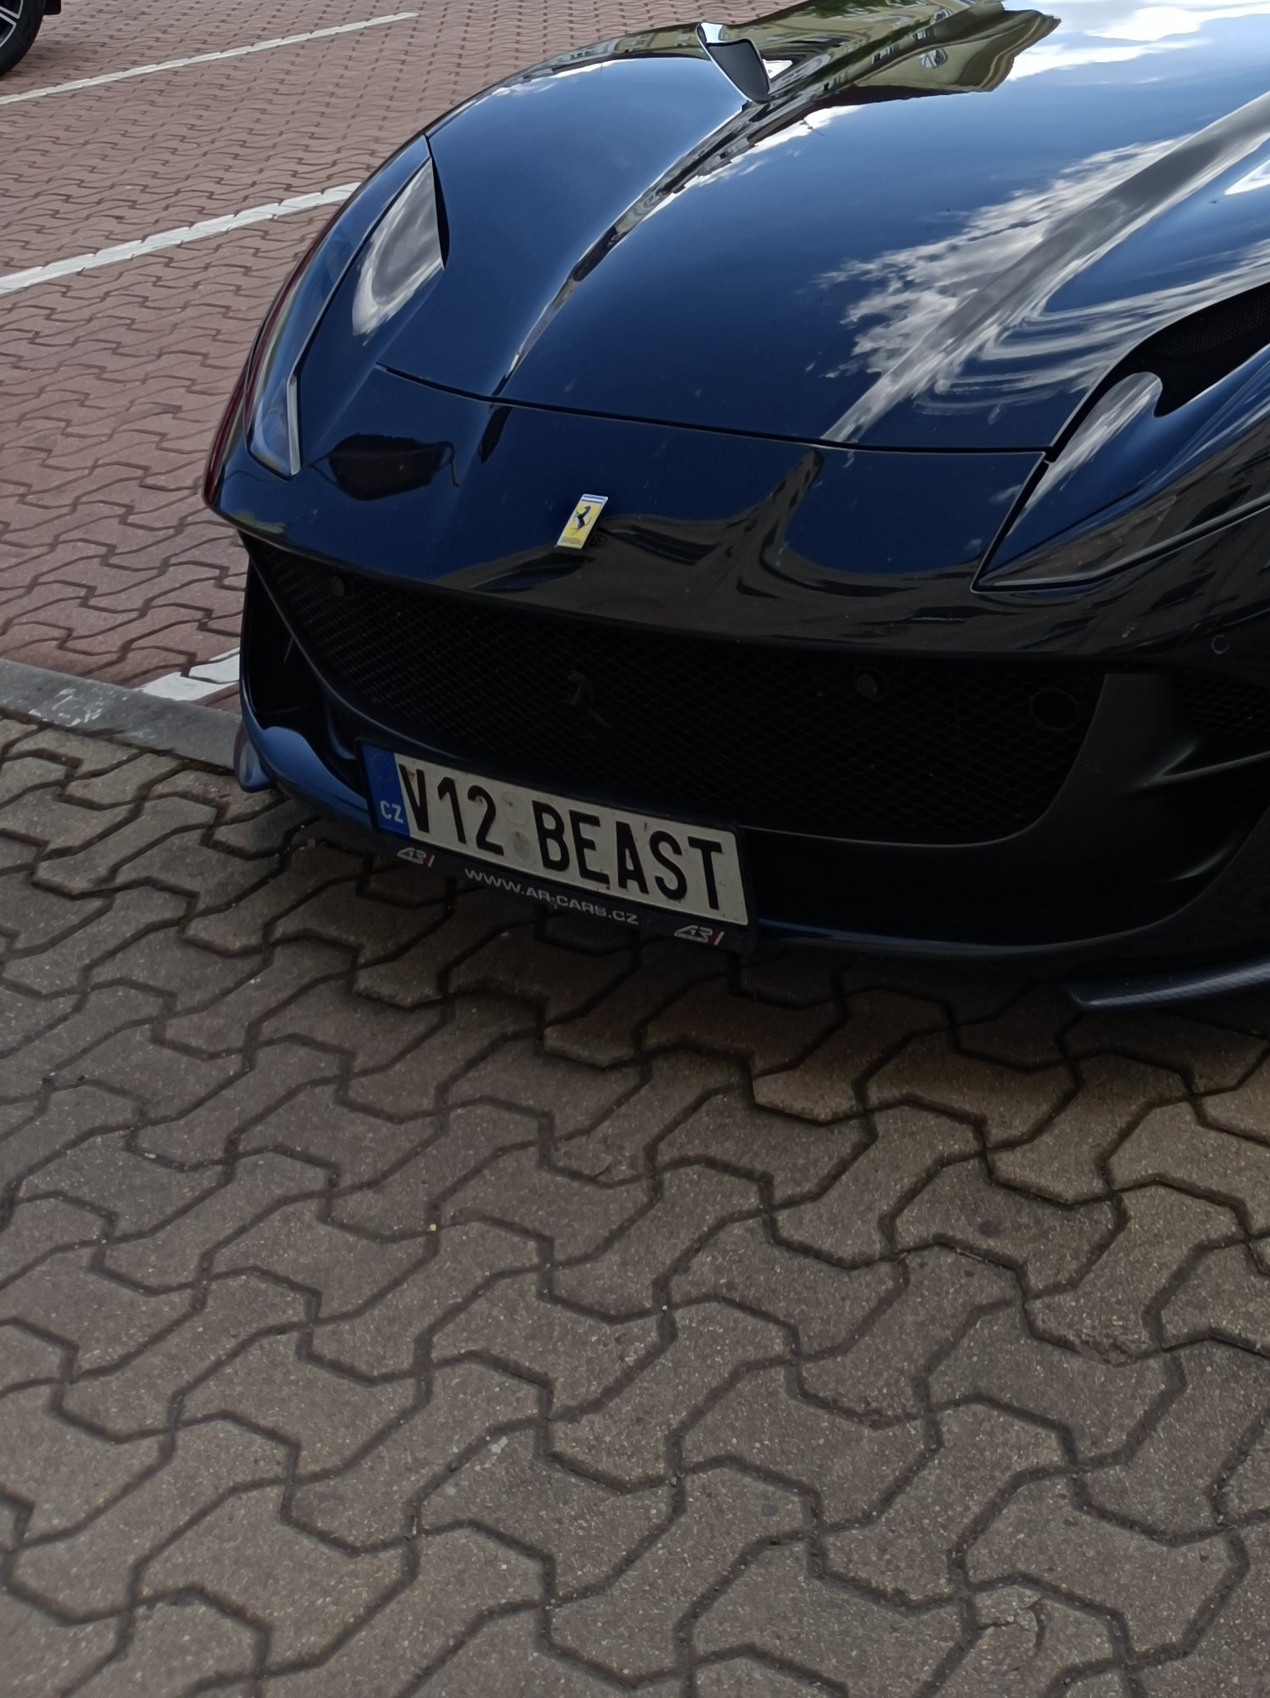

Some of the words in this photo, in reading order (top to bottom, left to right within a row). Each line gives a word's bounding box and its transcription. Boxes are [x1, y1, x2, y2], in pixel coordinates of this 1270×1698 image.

[379, 800, 404, 824] CZ
[398, 763, 505, 856] V12
[531, 799, 723, 911] BEAST
